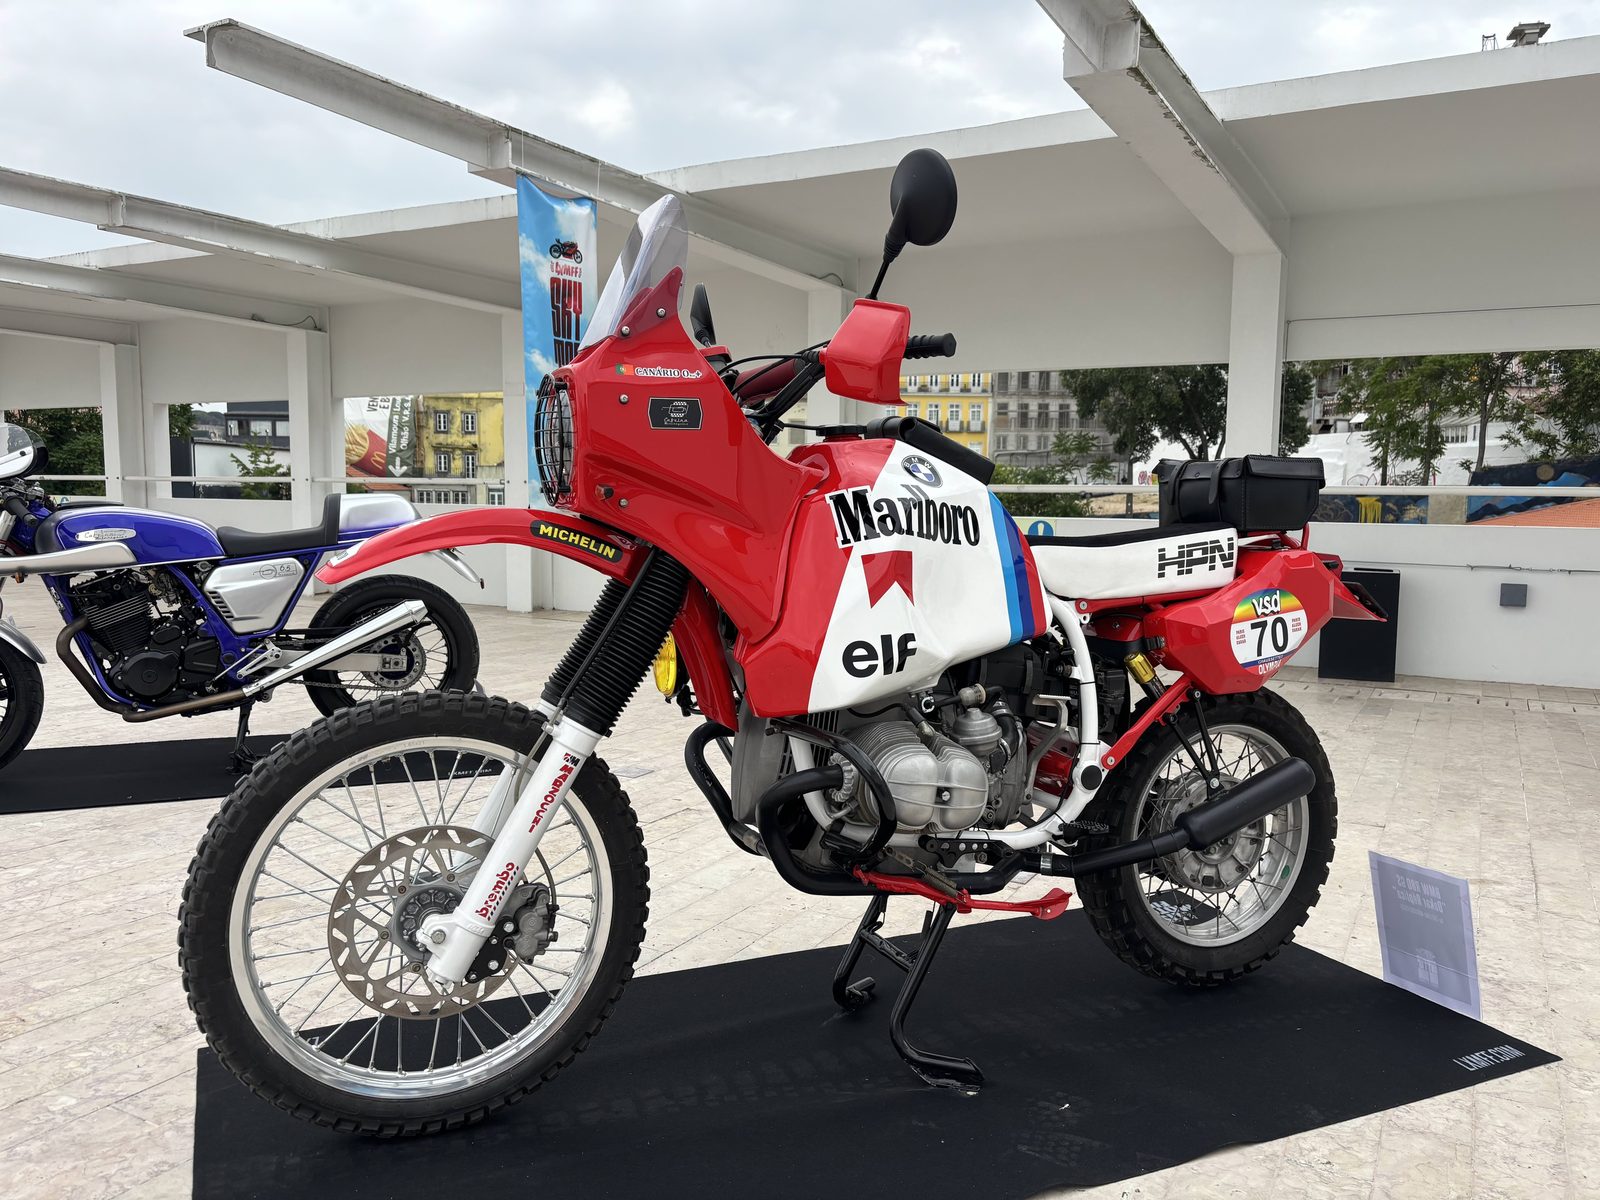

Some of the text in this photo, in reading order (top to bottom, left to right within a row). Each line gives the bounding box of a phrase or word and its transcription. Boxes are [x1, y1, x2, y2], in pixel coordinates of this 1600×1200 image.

[550, 277, 582, 341] SKY
[635, 366, 680, 377] CANÁRIO
[388, 415, 399, 454] Vilamoura
[400, 426, 409, 450] Olhão
[829, 484, 980, 547] Marlboro
[539, 524, 616, 559] MICHELIN
[1157, 537, 1234, 578] HPN
[842, 633, 917, 678] elf
[1250, 616, 1289, 657] 70
[528, 764, 575, 833] MARZOCCHI
[475, 862, 515, 919] brembo
